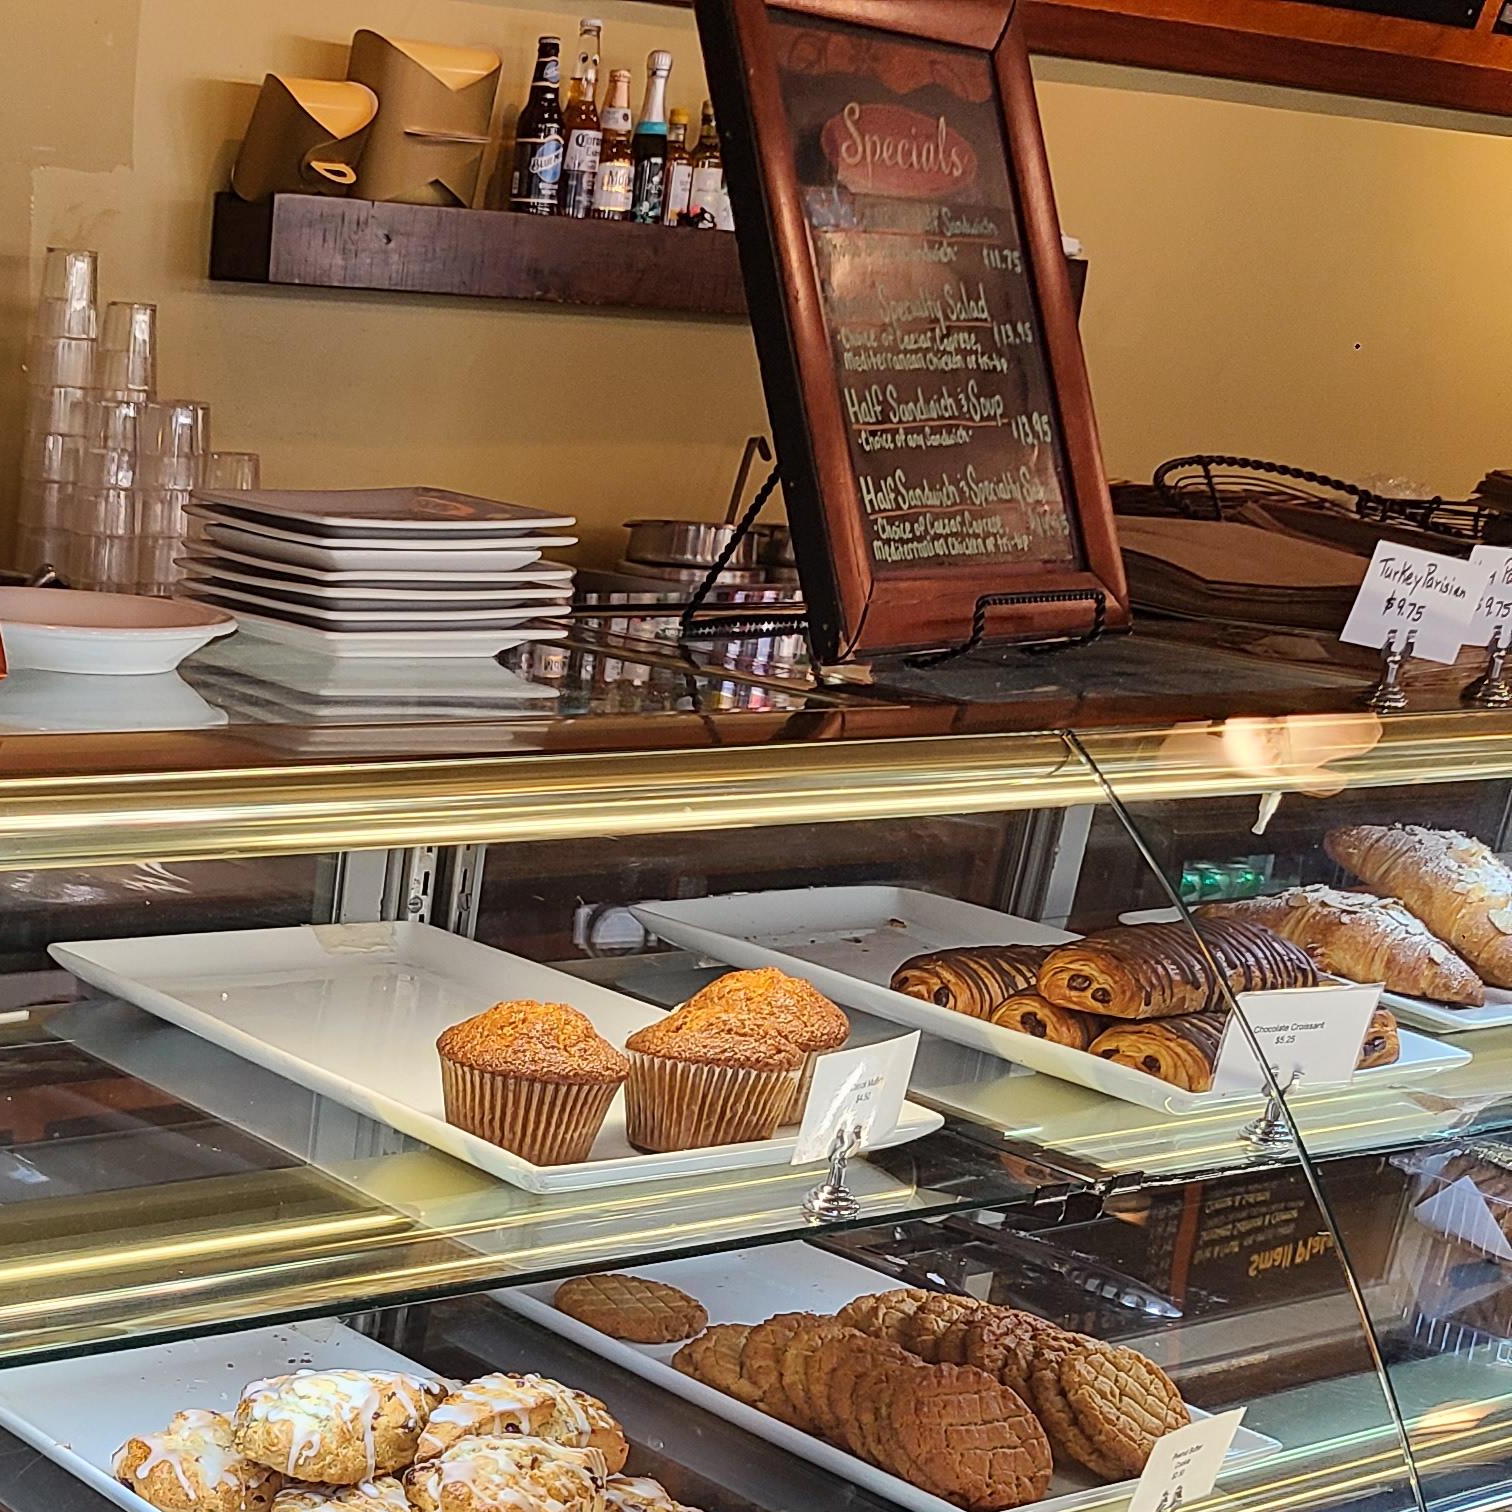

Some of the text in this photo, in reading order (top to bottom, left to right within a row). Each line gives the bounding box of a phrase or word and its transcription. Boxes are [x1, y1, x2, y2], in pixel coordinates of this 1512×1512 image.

[841, 102, 964, 188] Specials
[943, 282, 991, 323] Salad
[843, 384, 884, 424] Half
[886, 384, 959, 424] Sandwich
[968, 378, 1005, 427] Soup
[859, 474, 896, 514] Half
[895, 468, 960, 511] Sandwich
[966, 464, 1026, 512] Specialty
[1378, 556, 1425, 596] Turkey
[1423, 562, 1467, 600] Parisian
[1382, 590, 1427, 622] $9.75
[1254, 1021, 1326, 1035] Chocolate Croissant
[1275, 1035, 1296, 1045] $5.25
